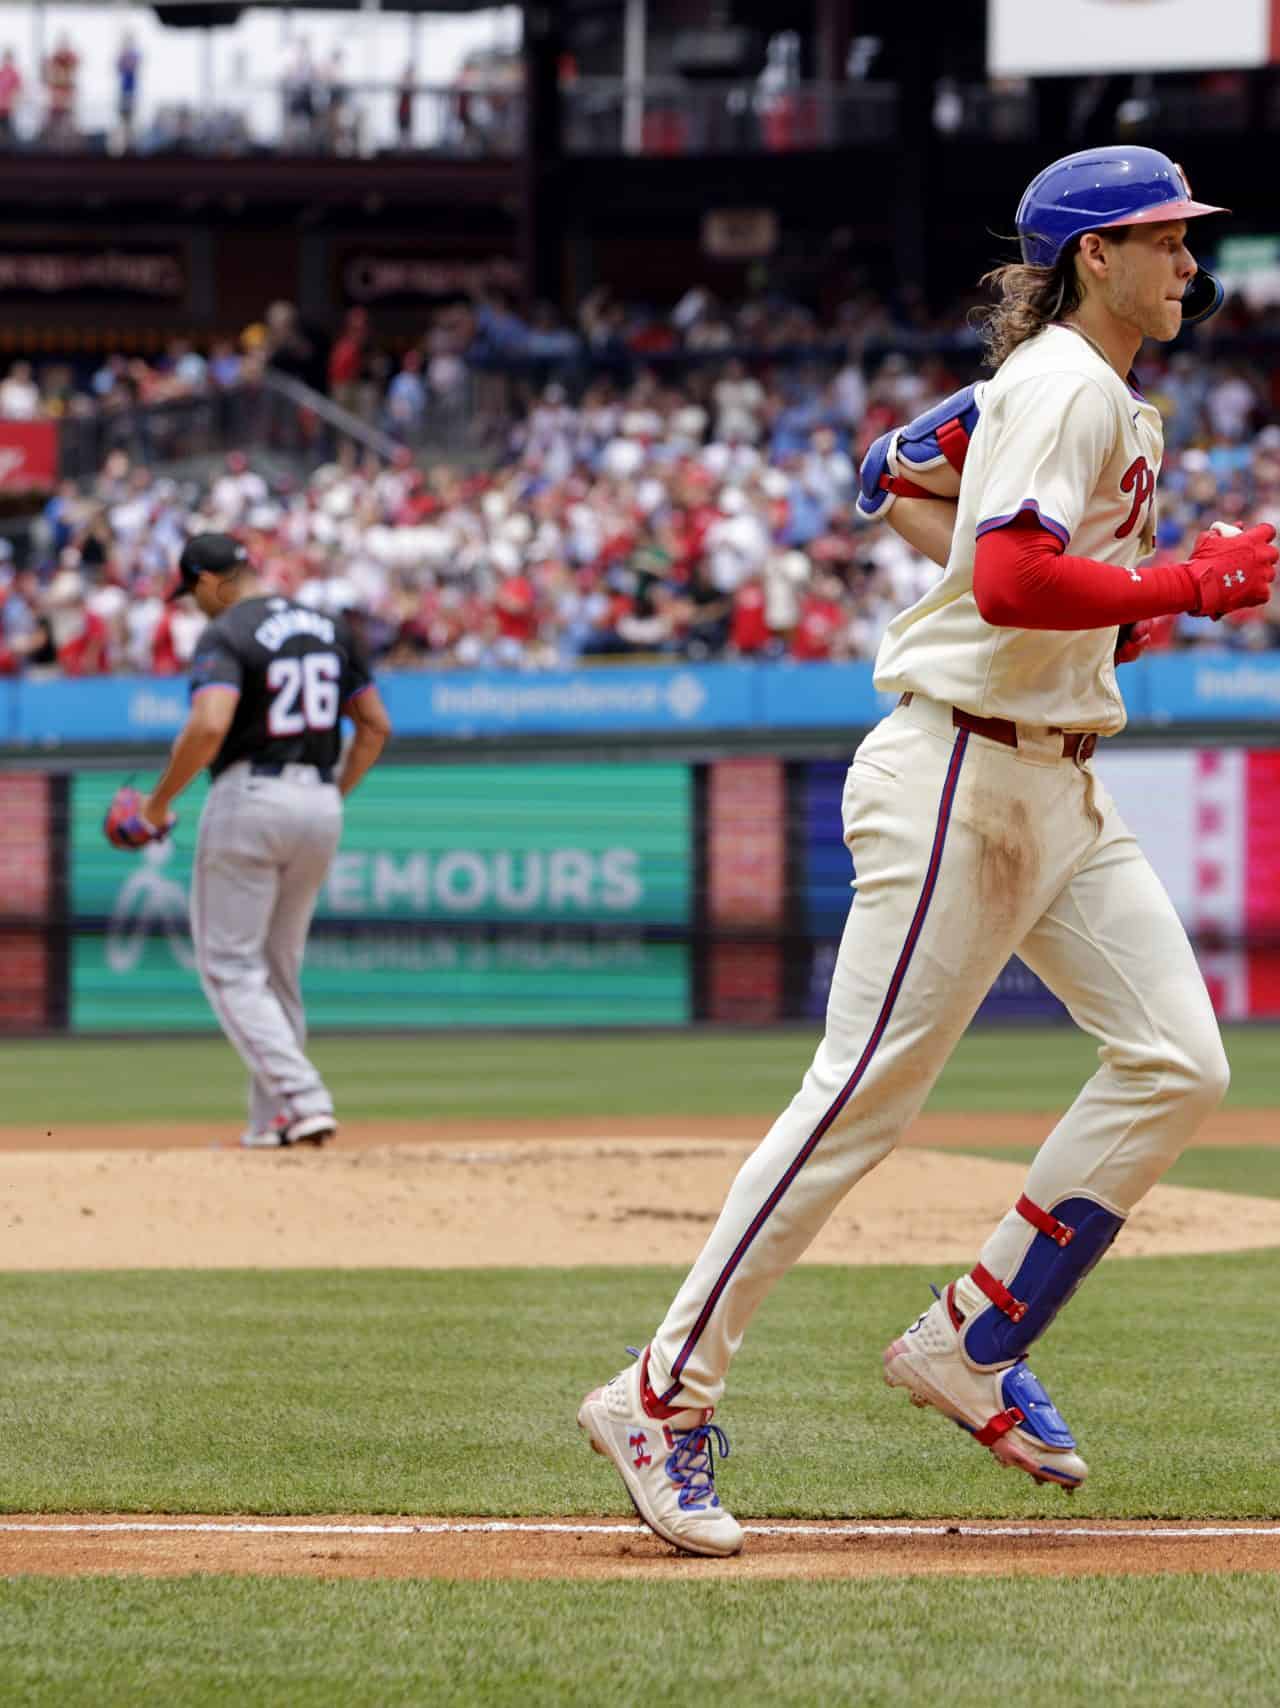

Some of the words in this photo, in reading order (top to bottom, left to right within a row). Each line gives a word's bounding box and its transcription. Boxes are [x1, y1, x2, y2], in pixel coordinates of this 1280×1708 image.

[266, 653, 341, 734] 26
[432, 679, 658, 718] Independence
[328, 848, 643, 910] EMOURS
